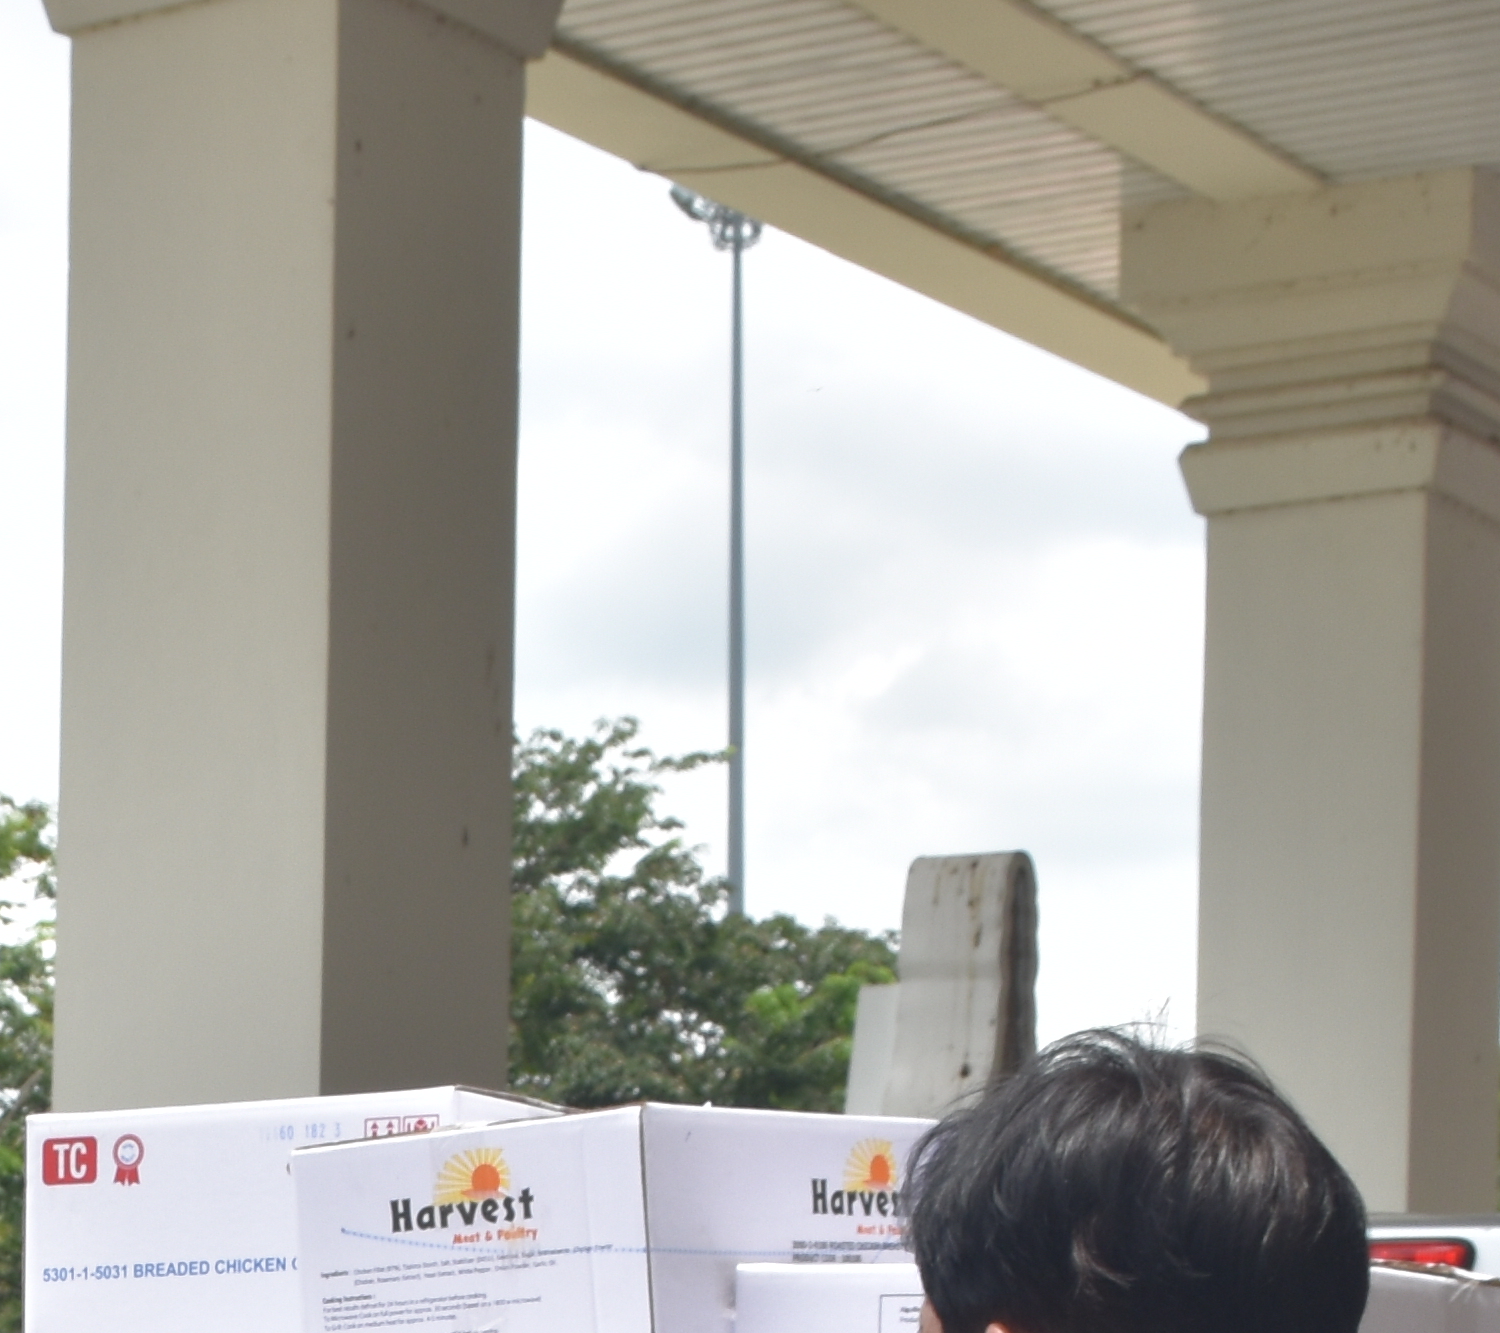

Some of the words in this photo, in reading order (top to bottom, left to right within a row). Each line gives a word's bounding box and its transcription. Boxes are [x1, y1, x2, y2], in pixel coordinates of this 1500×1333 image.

[52, 1141, 88, 1180] TC
[390, 1187, 535, 1234] Harvest
[453, 1231, 480, 1245] Meat
[497, 1226, 538, 1241] Poultry
[43, 1263, 129, 1284] 5301-1-5031
[133, 1259, 211, 1279] BREADED
[214, 1256, 287, 1276] CHICKEN
